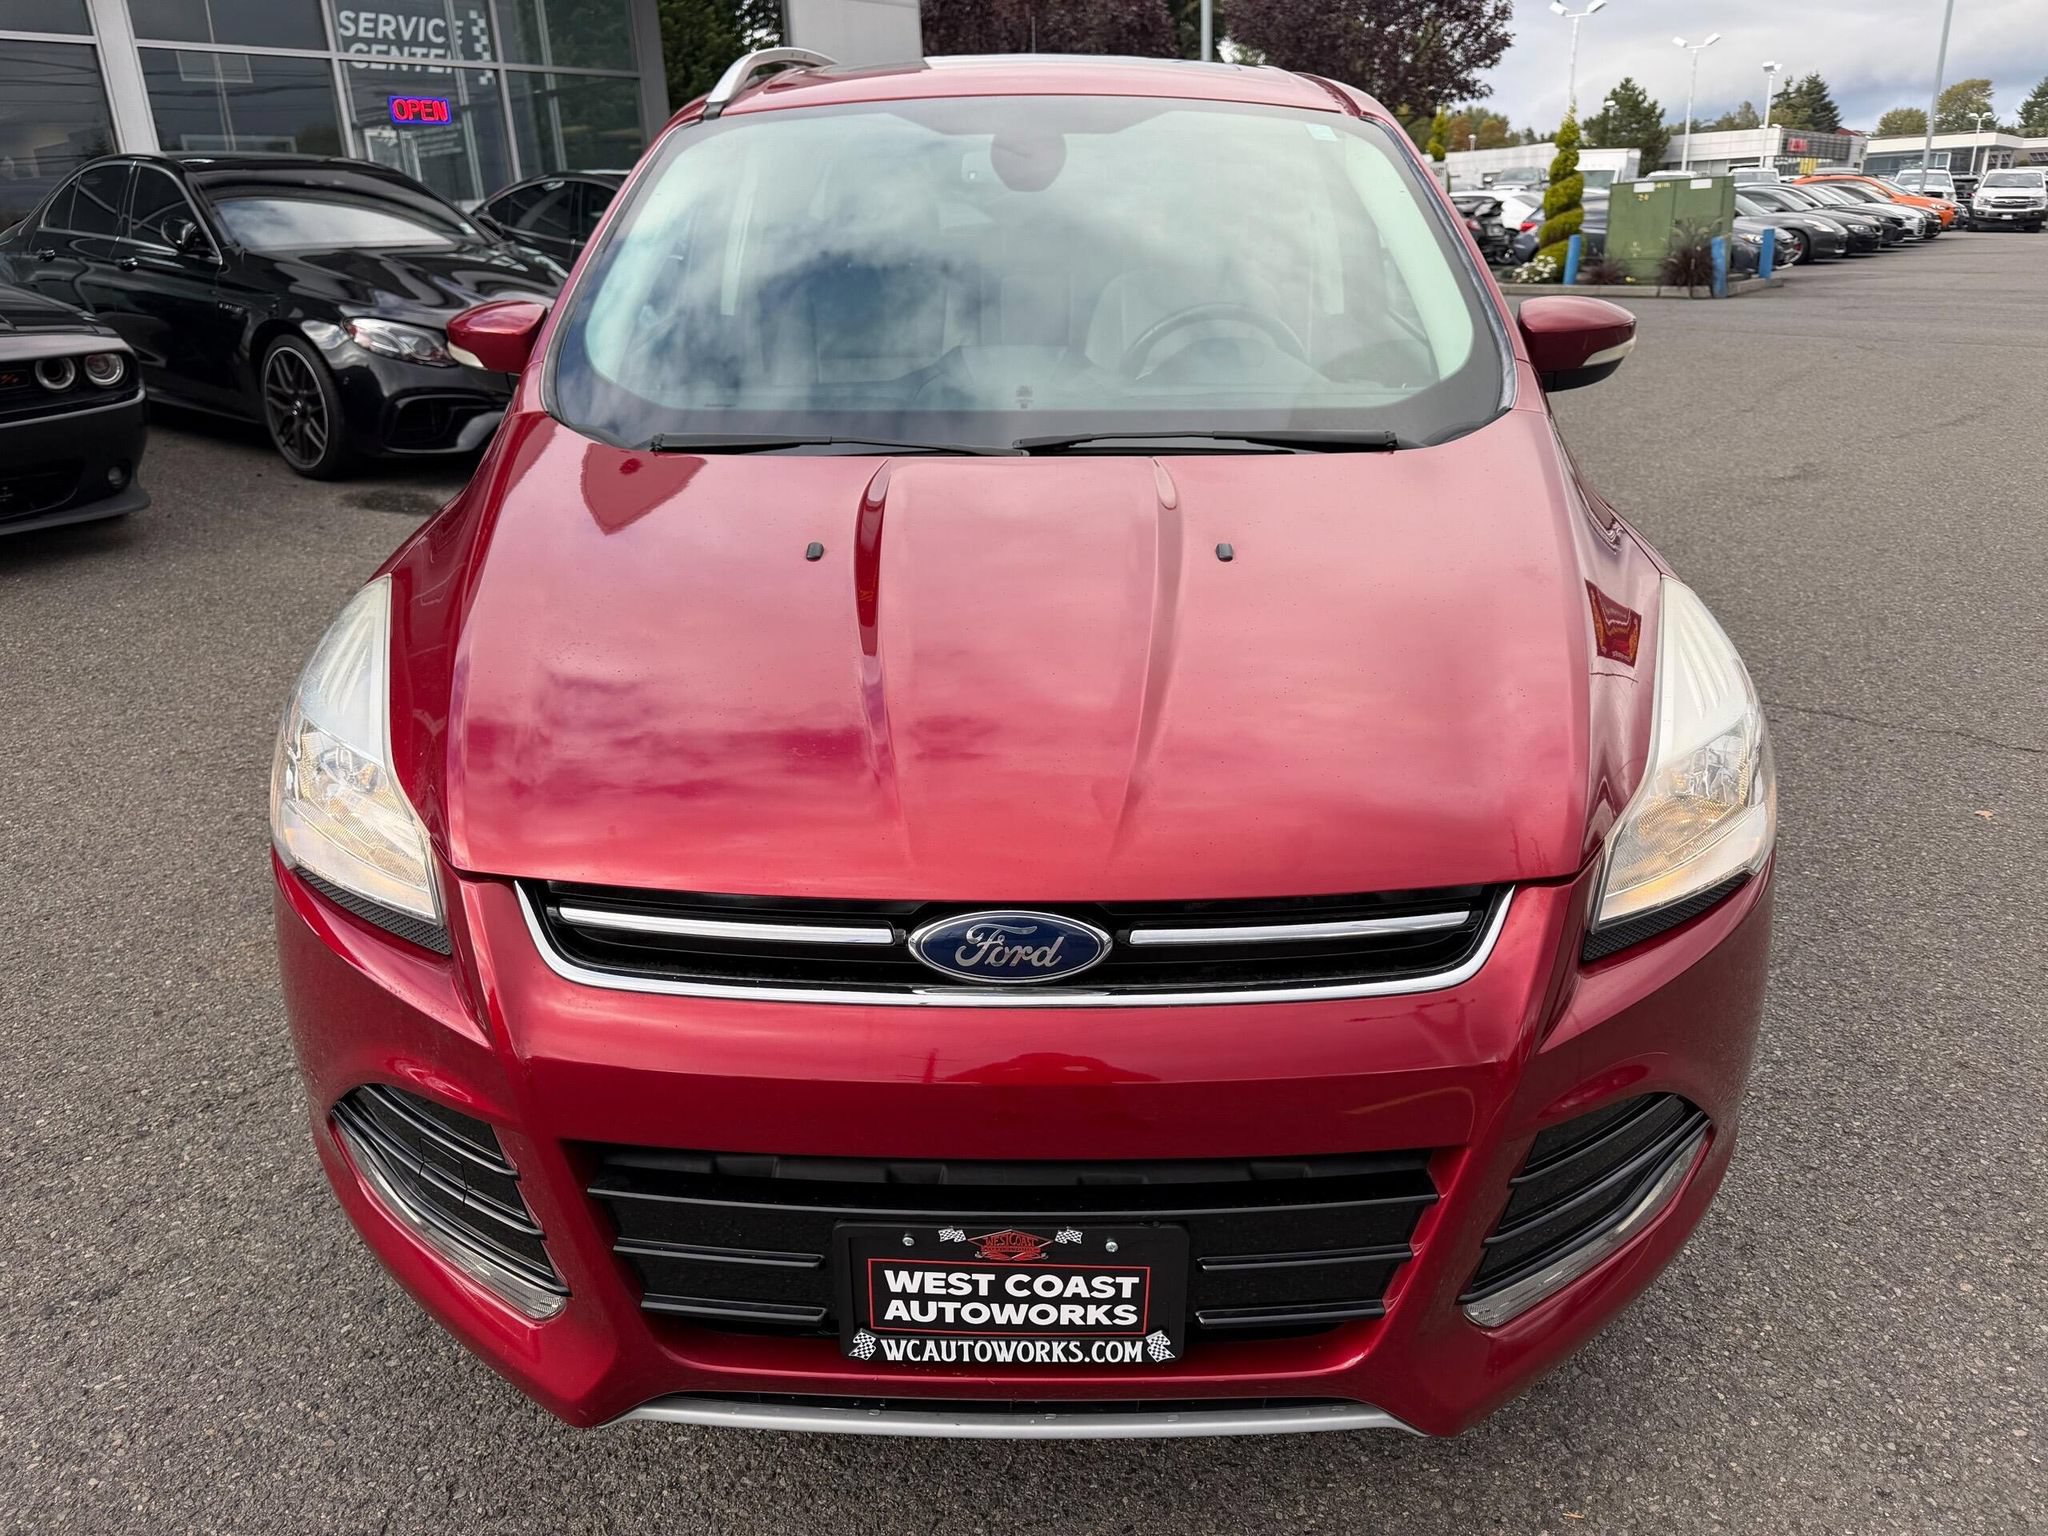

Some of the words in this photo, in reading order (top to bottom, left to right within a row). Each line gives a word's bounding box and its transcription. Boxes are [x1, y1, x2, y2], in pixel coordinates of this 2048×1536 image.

[350, 43, 455, 74] CENTE
[391, 98, 449, 122] OPEN
[954, 923, 1066, 967] Ford
[884, 1269, 996, 1297] WEST
[1004, 1273, 1140, 1299] COAST
[884, 1299, 1139, 1326] AUTOWORKS
[881, 1338, 1143, 1363] WCAUTOWORKS.COM
